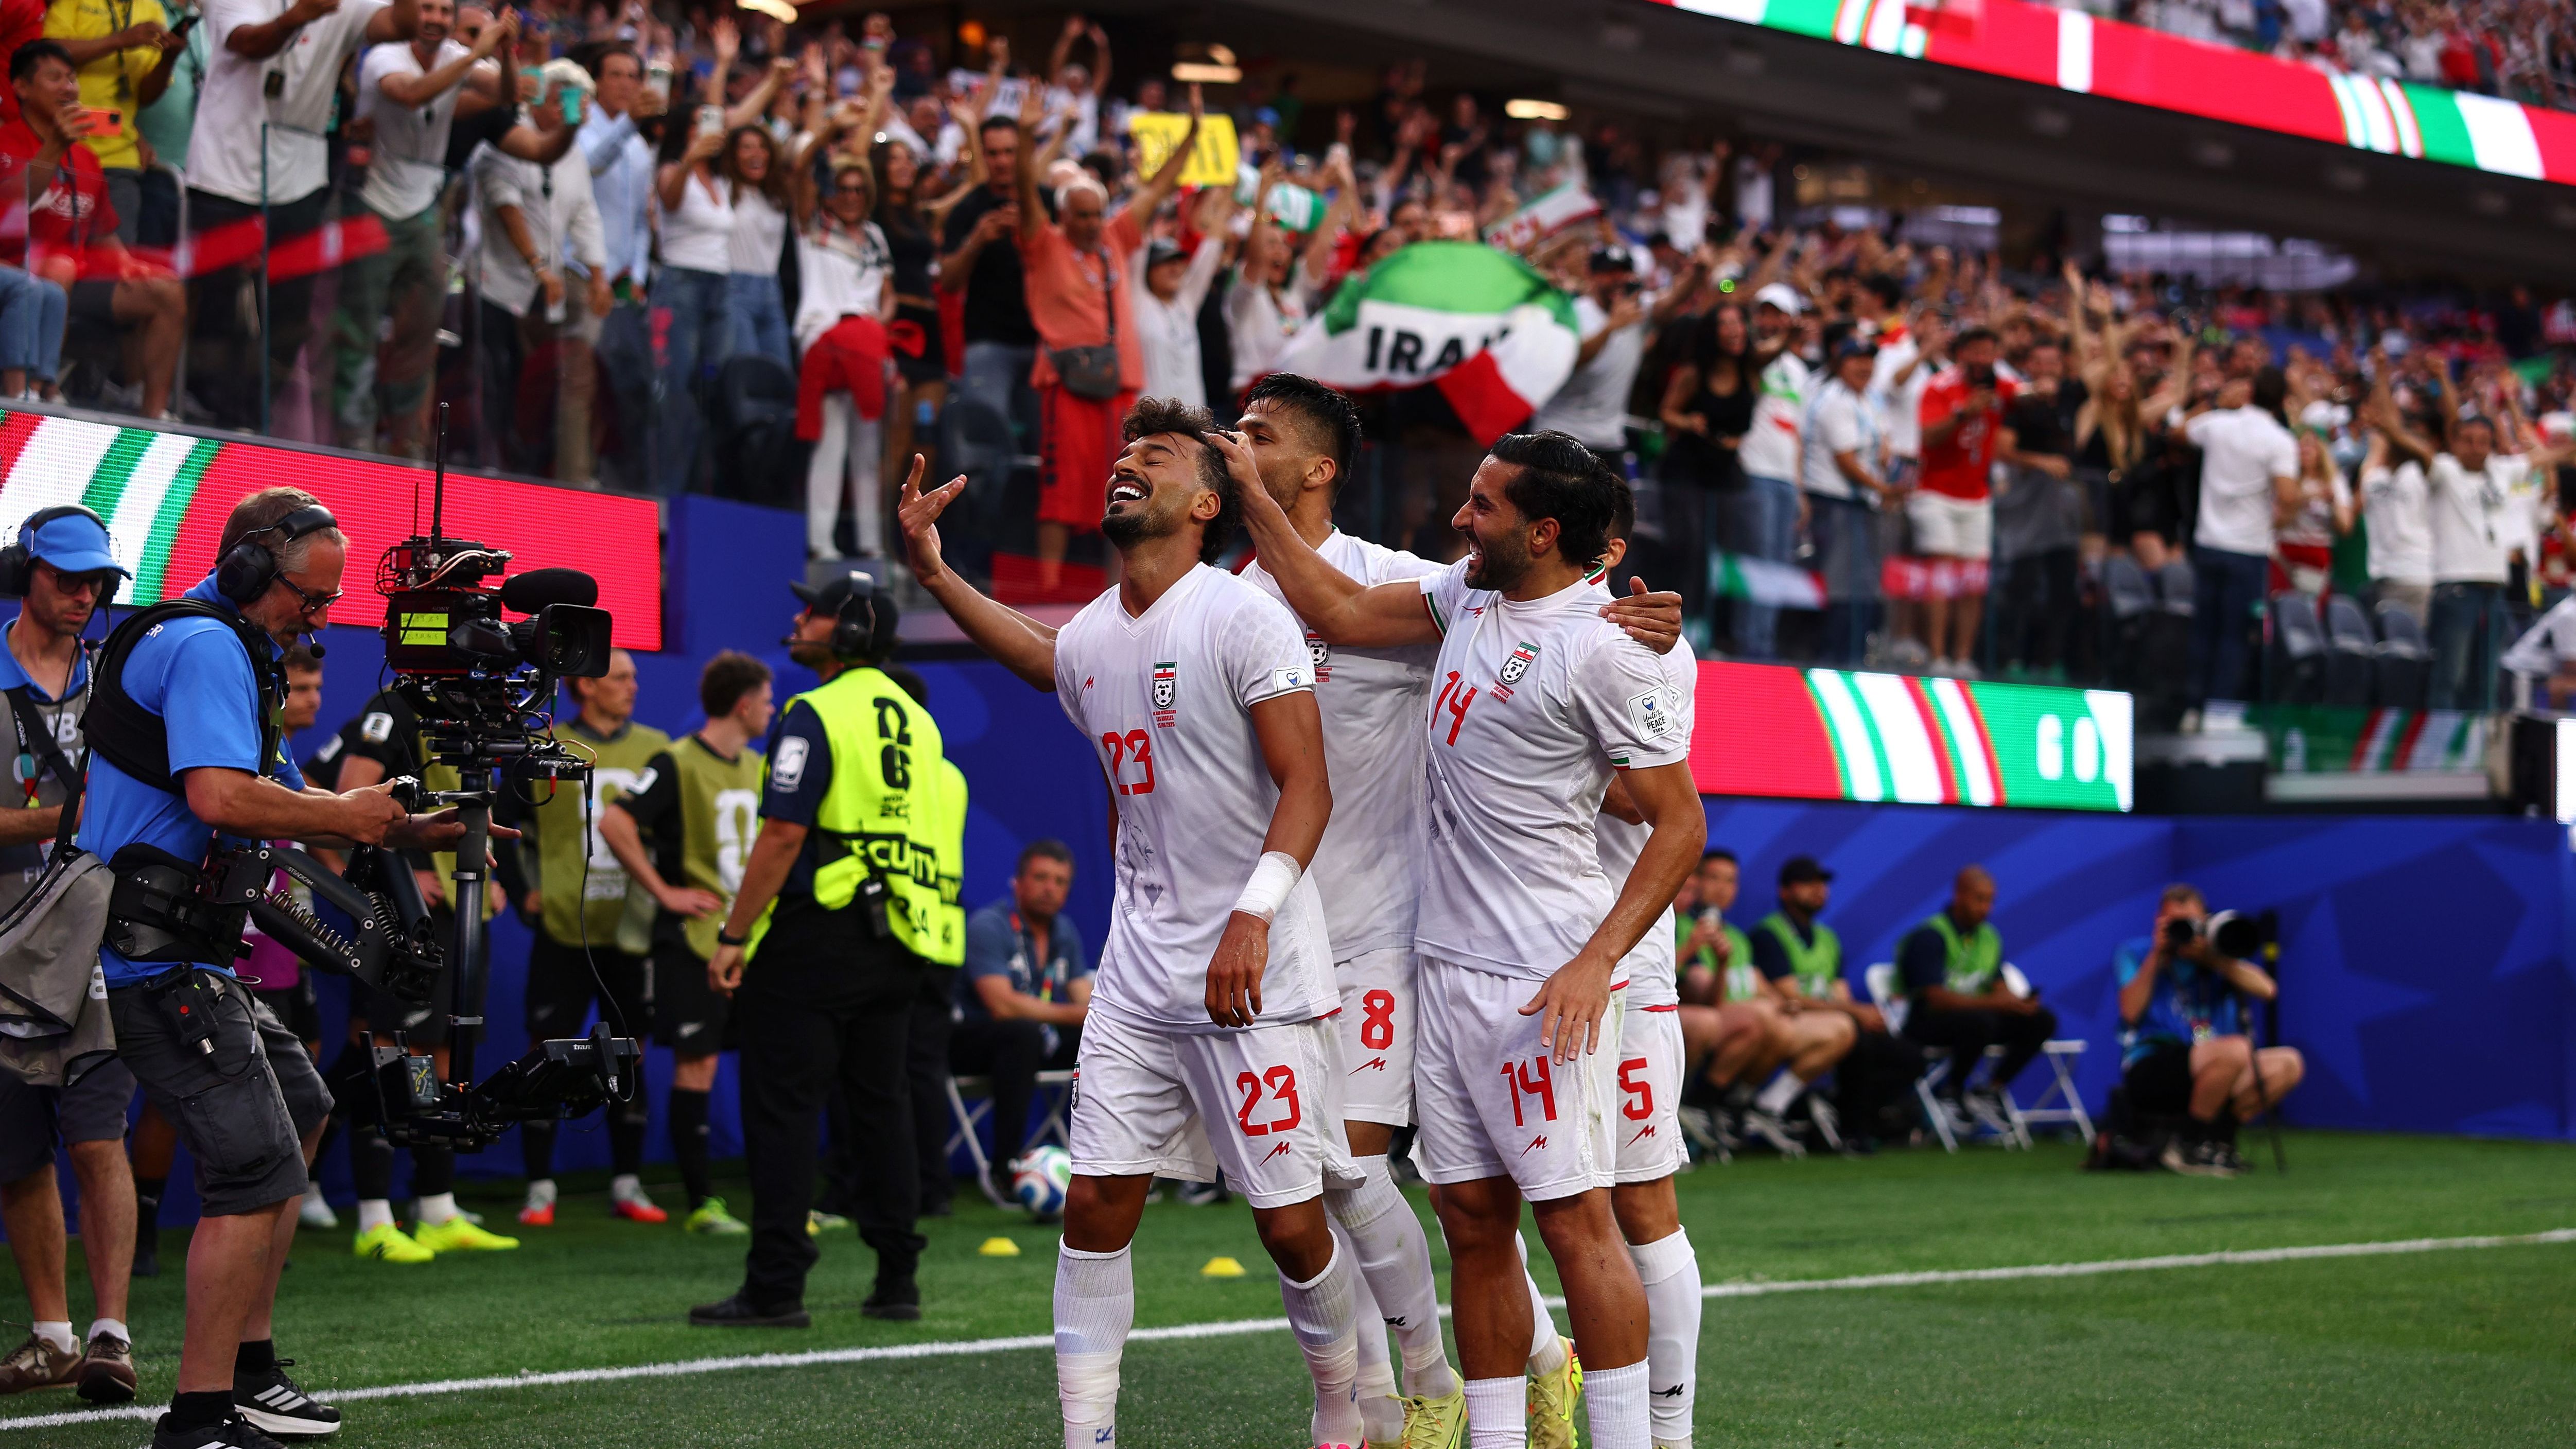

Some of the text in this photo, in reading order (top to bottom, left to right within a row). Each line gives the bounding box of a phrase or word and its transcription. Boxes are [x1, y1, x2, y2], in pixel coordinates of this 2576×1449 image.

[1366, 326, 1510, 374] IRA
[1431, 670, 1478, 747] 14
[1643, 711, 1657, 723] Unite
[1646, 716, 1666, 730] PEACE
[1103, 729, 1156, 796] 23
[288, 866, 314, 886] STEADICAM
[313, 937, 327, 950] G-70x
[1361, 989, 1395, 1050] 8
[1236, 1064, 1301, 1137] 23
[1500, 1055, 1558, 1127] 14
